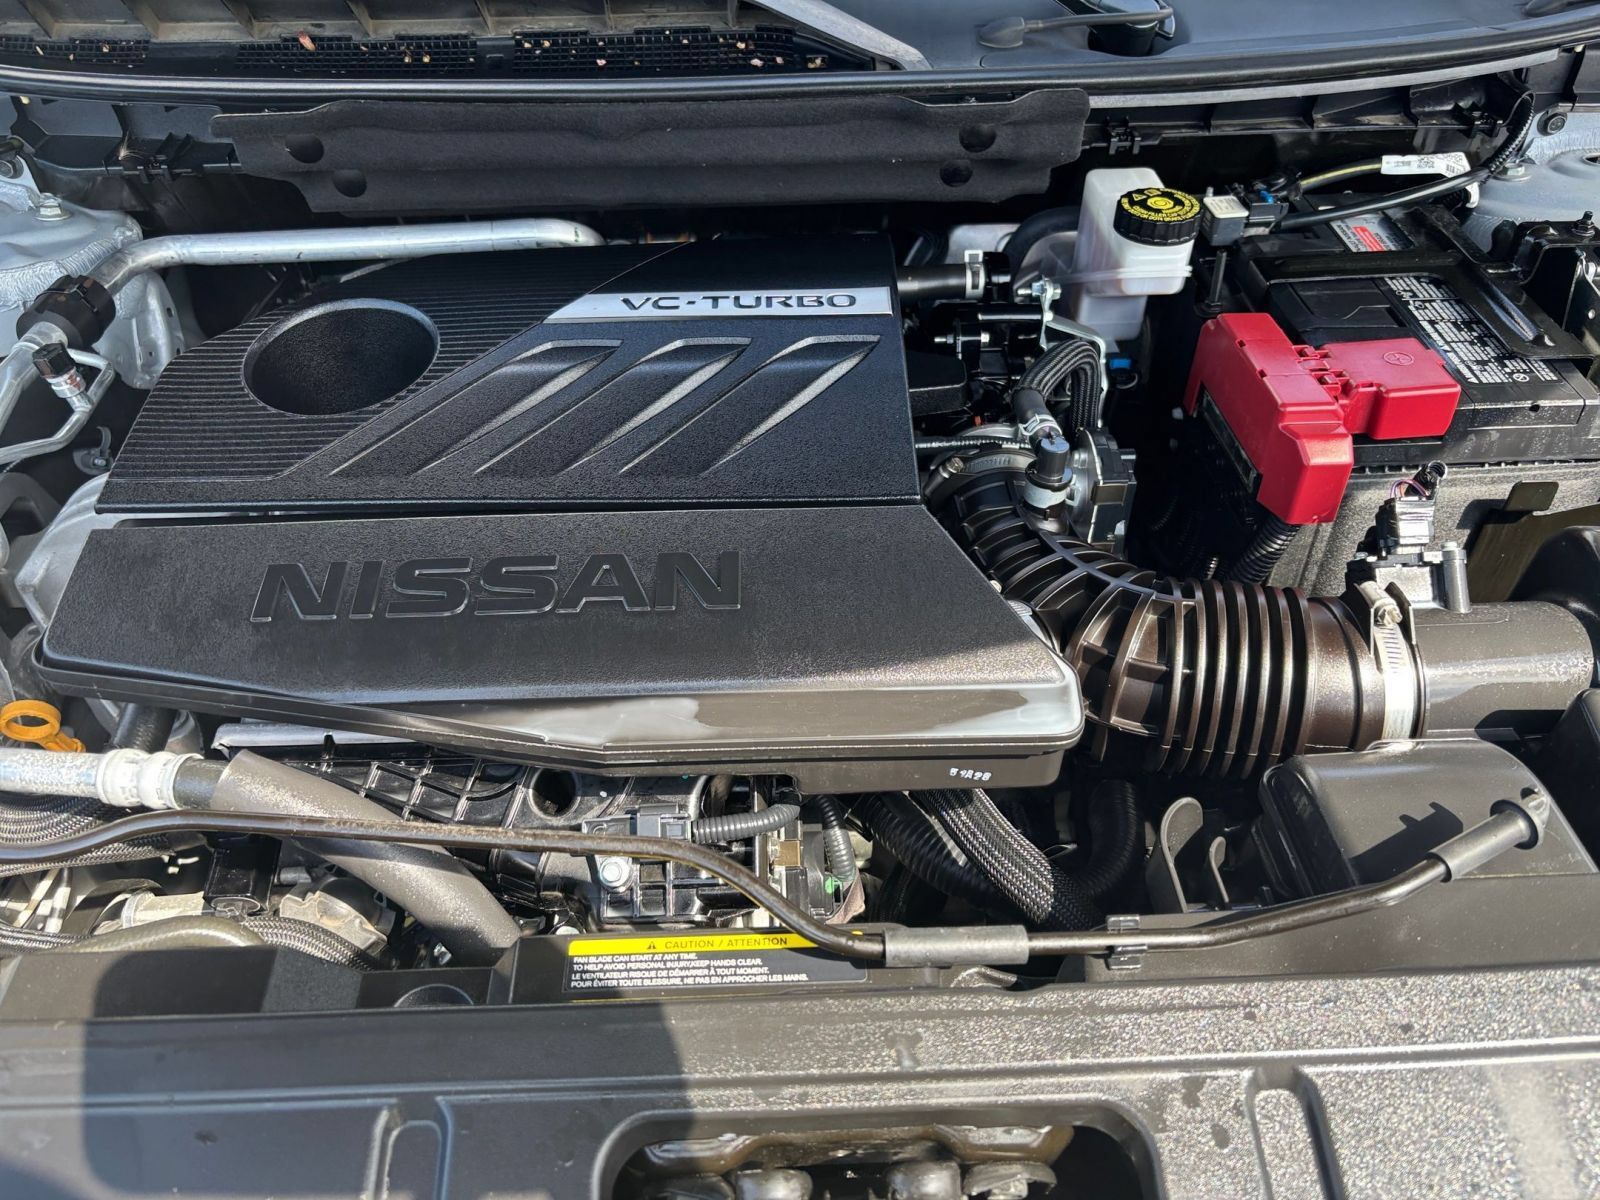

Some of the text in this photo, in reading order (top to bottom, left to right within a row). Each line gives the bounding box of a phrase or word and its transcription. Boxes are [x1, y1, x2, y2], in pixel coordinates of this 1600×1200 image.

[250, 550, 742, 622] NISSAN
[664, 940, 714, 950] CAUTION
[727, 937, 788, 948] ATTENTION
[680, 952, 698, 960] TIME.
[603, 962, 626, 970] AVOID
[627, 961, 665, 969] PERSONAL
[582, 971, 629, 979] VENTILATEUR
[629, 970, 656, 978] RISQUE
[669, 967, 709, 976] DÉMARRER
[709, 967, 716, 975] À
[571, 980, 592, 988] POUR
[593, 978, 618, 987] ÉVITER
[619, 979, 642, 987] TOUTE
[695, 976, 710, 984] PAS
[723, 974, 768, 983] APPROCHER
[768, 974, 783, 982] LES
[783, 973, 809, 981] MAINS.
